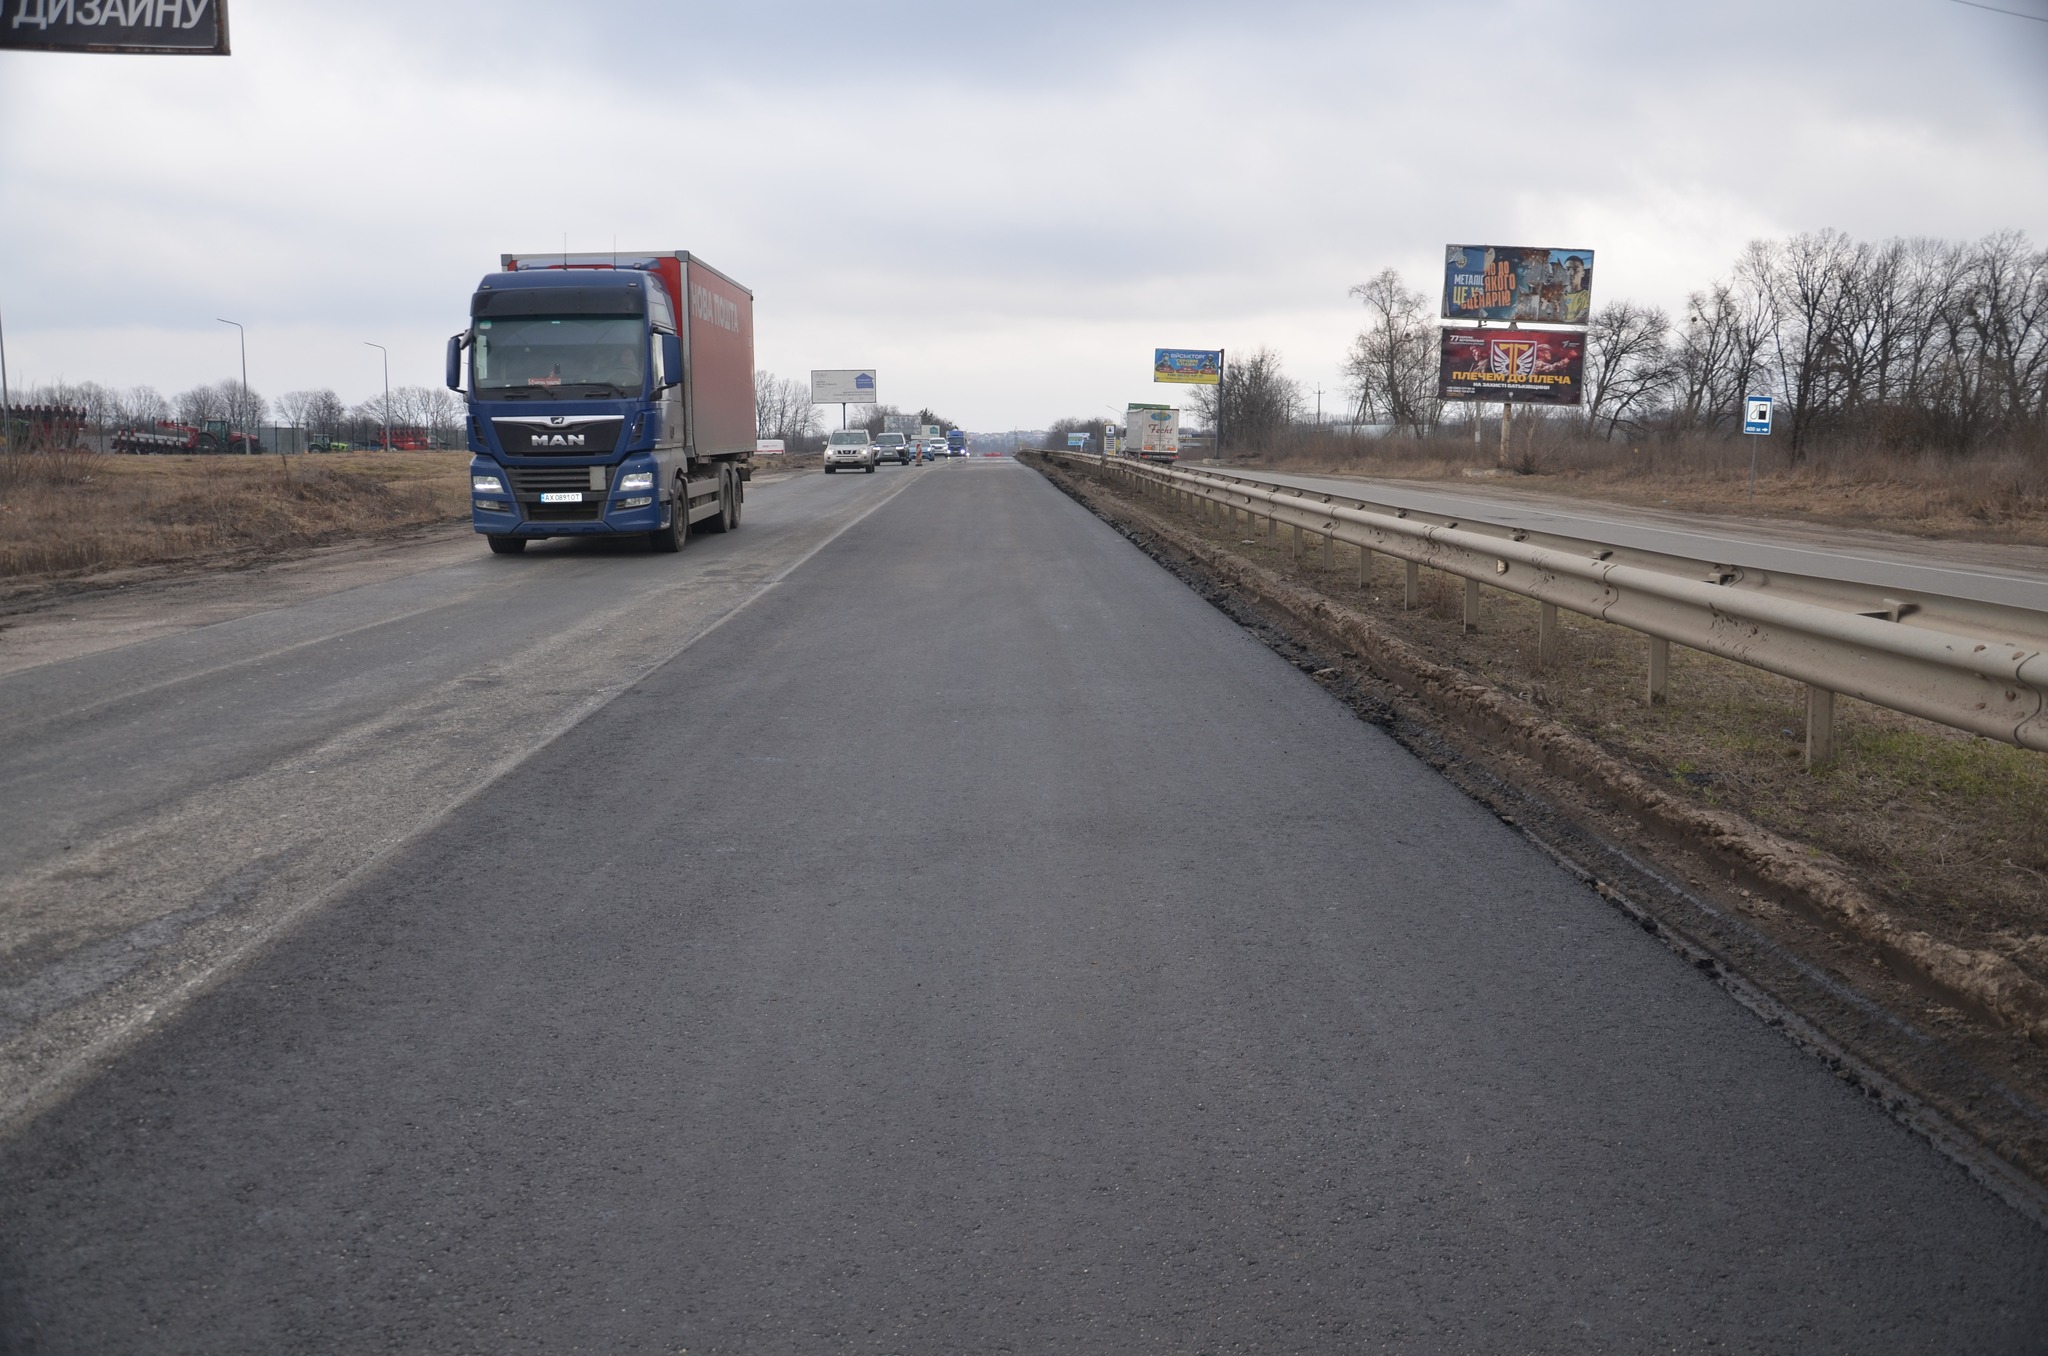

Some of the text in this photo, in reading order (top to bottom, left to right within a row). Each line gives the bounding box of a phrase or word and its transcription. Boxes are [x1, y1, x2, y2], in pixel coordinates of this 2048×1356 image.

[1484, 273, 1516, 292] ЯКОГО
[690, 281, 739, 335] НОВА ПОШТА
[1452, 371, 1571, 385] ПЛЕЧЕМ ДО ПЛЕЧА
[531, 434, 585, 446] MAN
